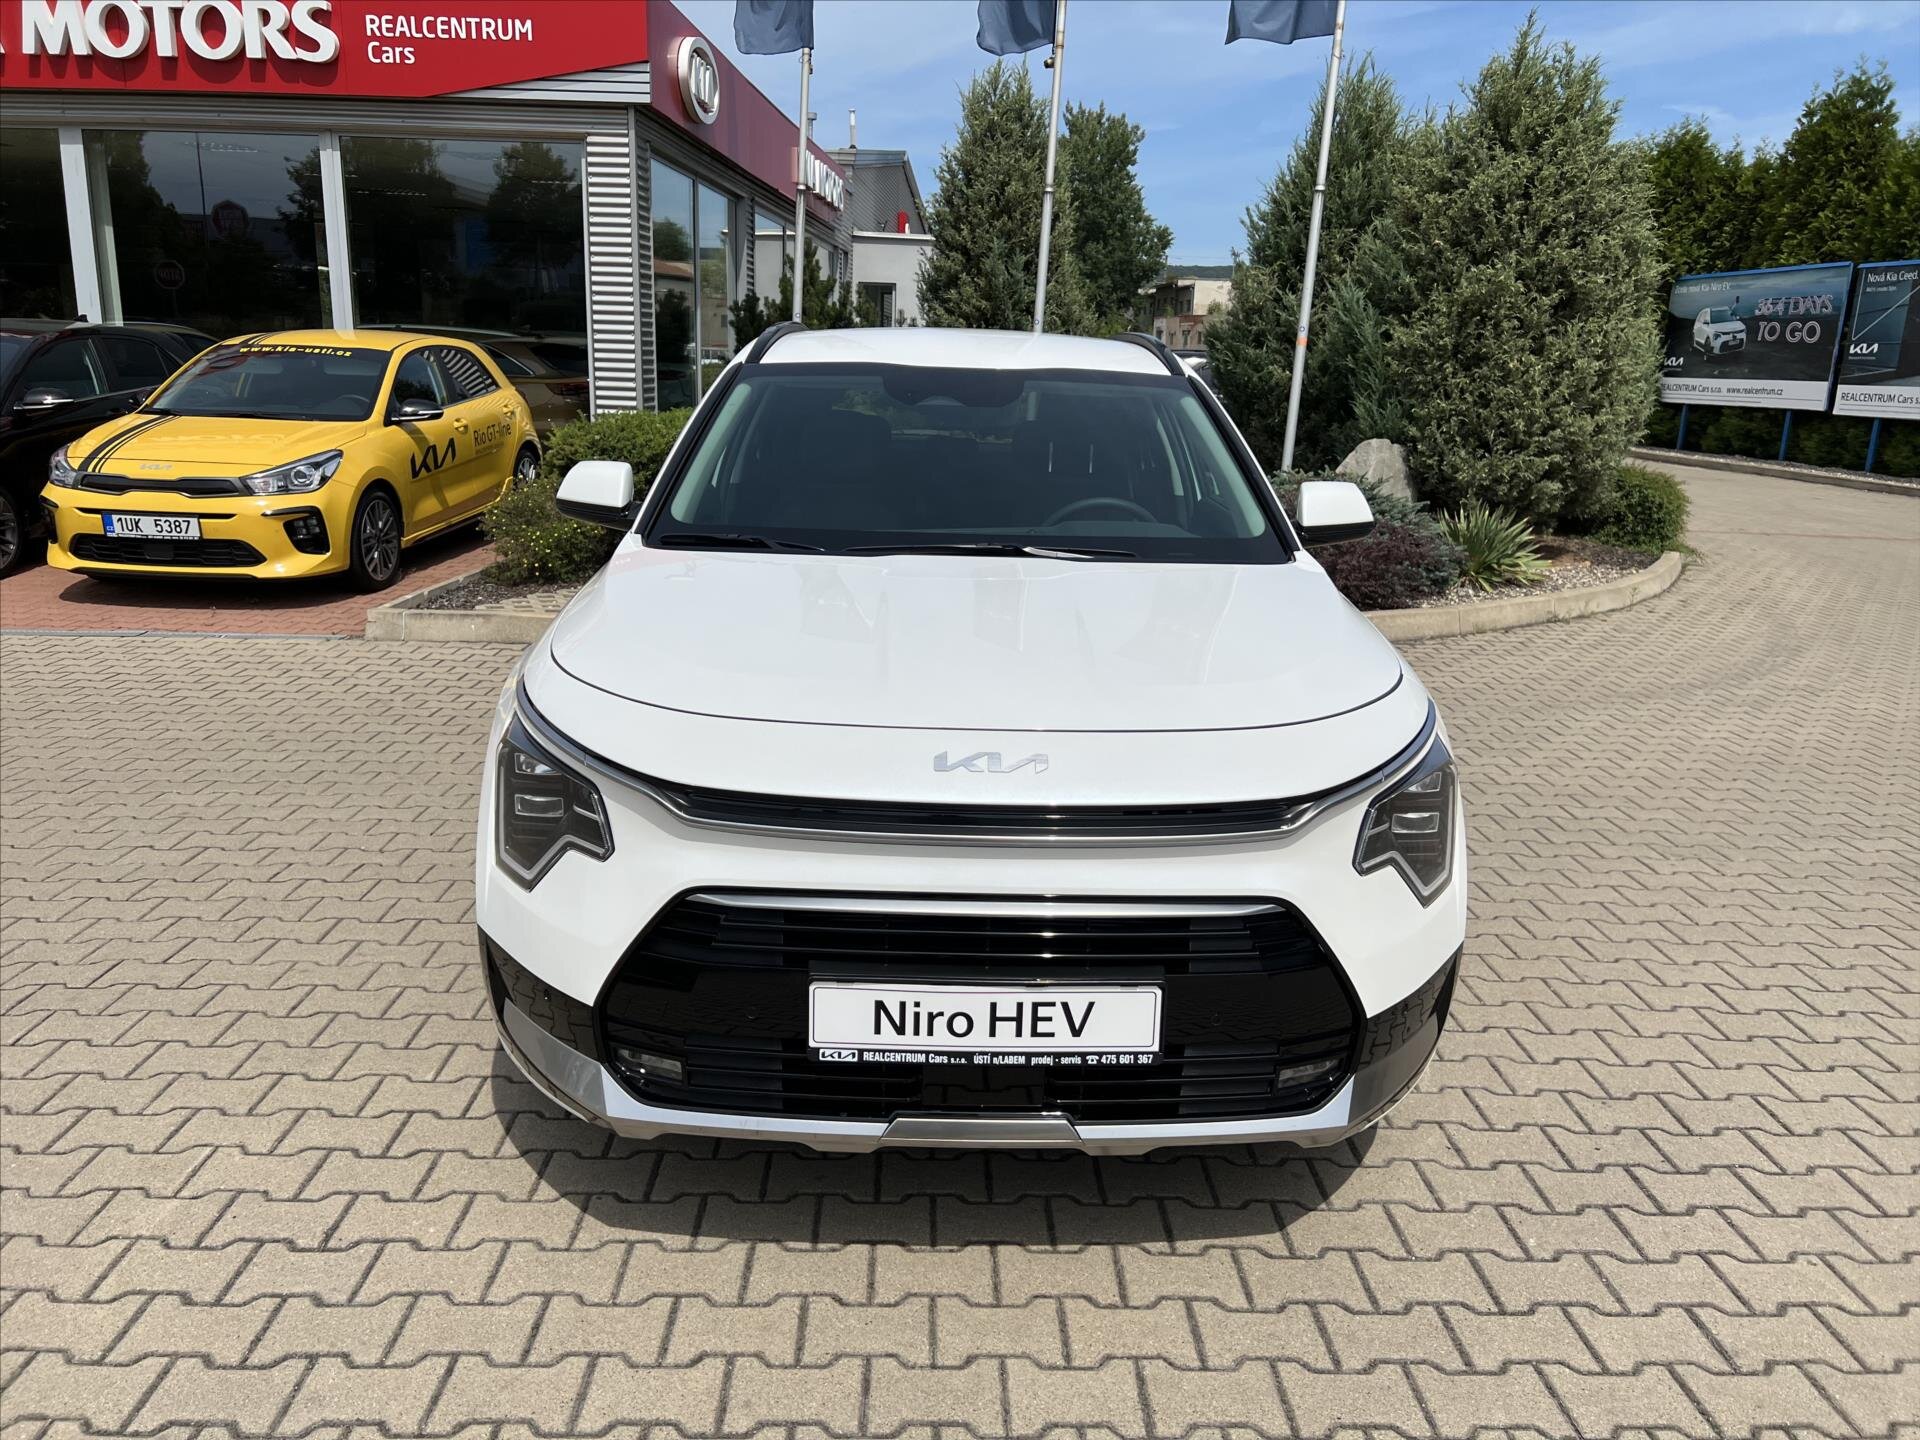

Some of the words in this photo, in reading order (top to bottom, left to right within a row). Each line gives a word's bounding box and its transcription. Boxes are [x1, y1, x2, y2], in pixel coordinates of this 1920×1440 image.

[21, 0, 341, 63] MOTORS
[365, 14, 533, 42] REALCENTRUM
[367, 41, 416, 65] Cars
[1867, 272, 1885, 283] Nová
[1887, 271, 1898, 281] Kia
[1788, 294, 1834, 315] DAYS
[1757, 321, 1781, 342] TO
[1785, 321, 1821, 344] GO
[1841, 392, 1896, 403] REALCENTRUM
[1897, 394, 1914, 405] Cars
[473, 429, 487, 448] Rio
[410, 437, 457, 479] KIA
[117, 517, 144, 533] 1UK
[153, 519, 191, 534] 5387
[933, 751, 1048, 774] KIA
[873, 1000, 974, 1037] Niro
[989, 1001, 1096, 1038] HEV
[863, 1052, 926, 1063] REALCENTRUM
[928, 1053, 948, 1064] Cars
[974, 1053, 991, 1065] ÚSTÍ
[992, 1055, 1026, 1065] n/LABEM
[1031, 1055, 1054, 1066] prodej
[1060, 1056, 1082, 1065] servis
[1101, 1054, 1117, 1065] 475
[1119, 1054, 1134, 1064] 601
[1137, 1054, 1153, 1064] 367
